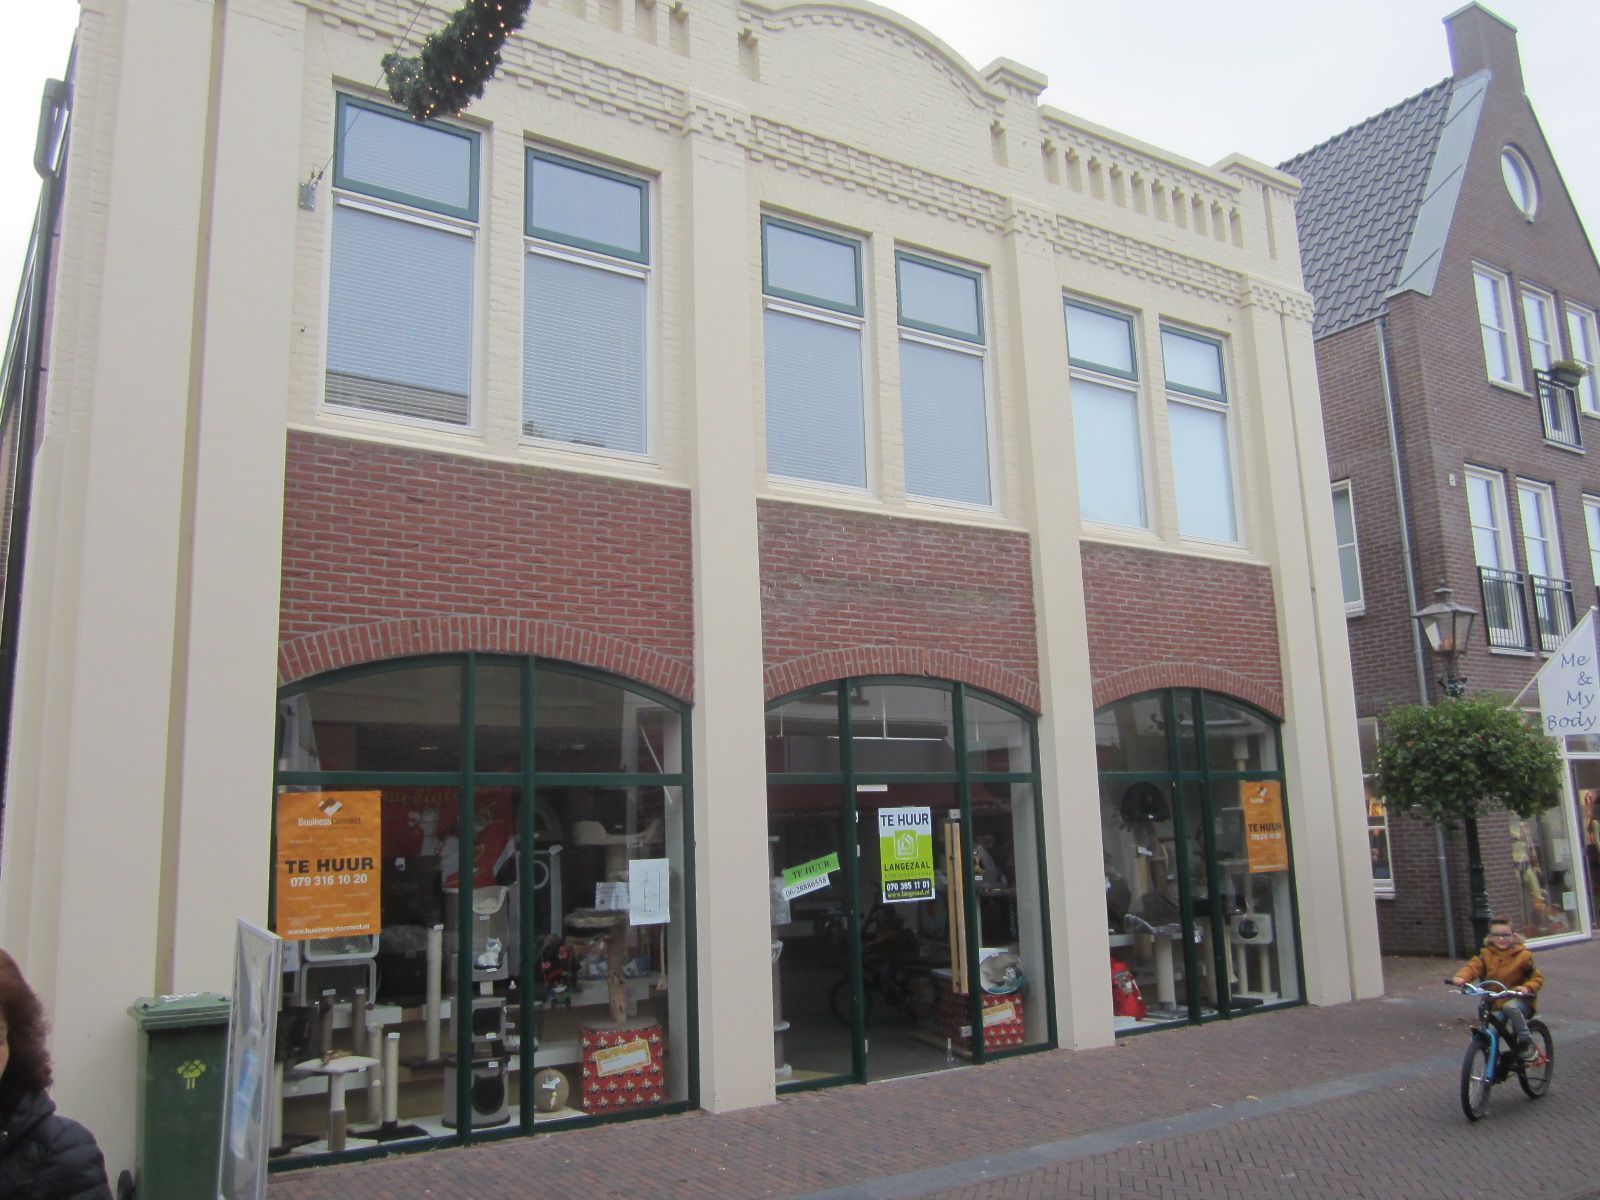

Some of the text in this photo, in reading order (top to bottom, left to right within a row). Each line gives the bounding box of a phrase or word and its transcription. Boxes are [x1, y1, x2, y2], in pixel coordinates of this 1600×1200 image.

[1560, 653, 1590, 668] Me
[1577, 671, 1593, 686] &
[1566, 690, 1595, 709] My
[1546, 711, 1597, 731] Body
[880, 813, 929, 827] TE HUUR
[1248, 823, 1283, 833] TE HUUR
[284, 857, 375, 874] TE HUUR
[884, 861, 931, 871] LANGEZAAL
[290, 873, 368, 888] 079 316 10 20
[886, 882, 899, 891] 070
[914, 881, 921, 889] 11
[922, 880, 930, 889] 01
